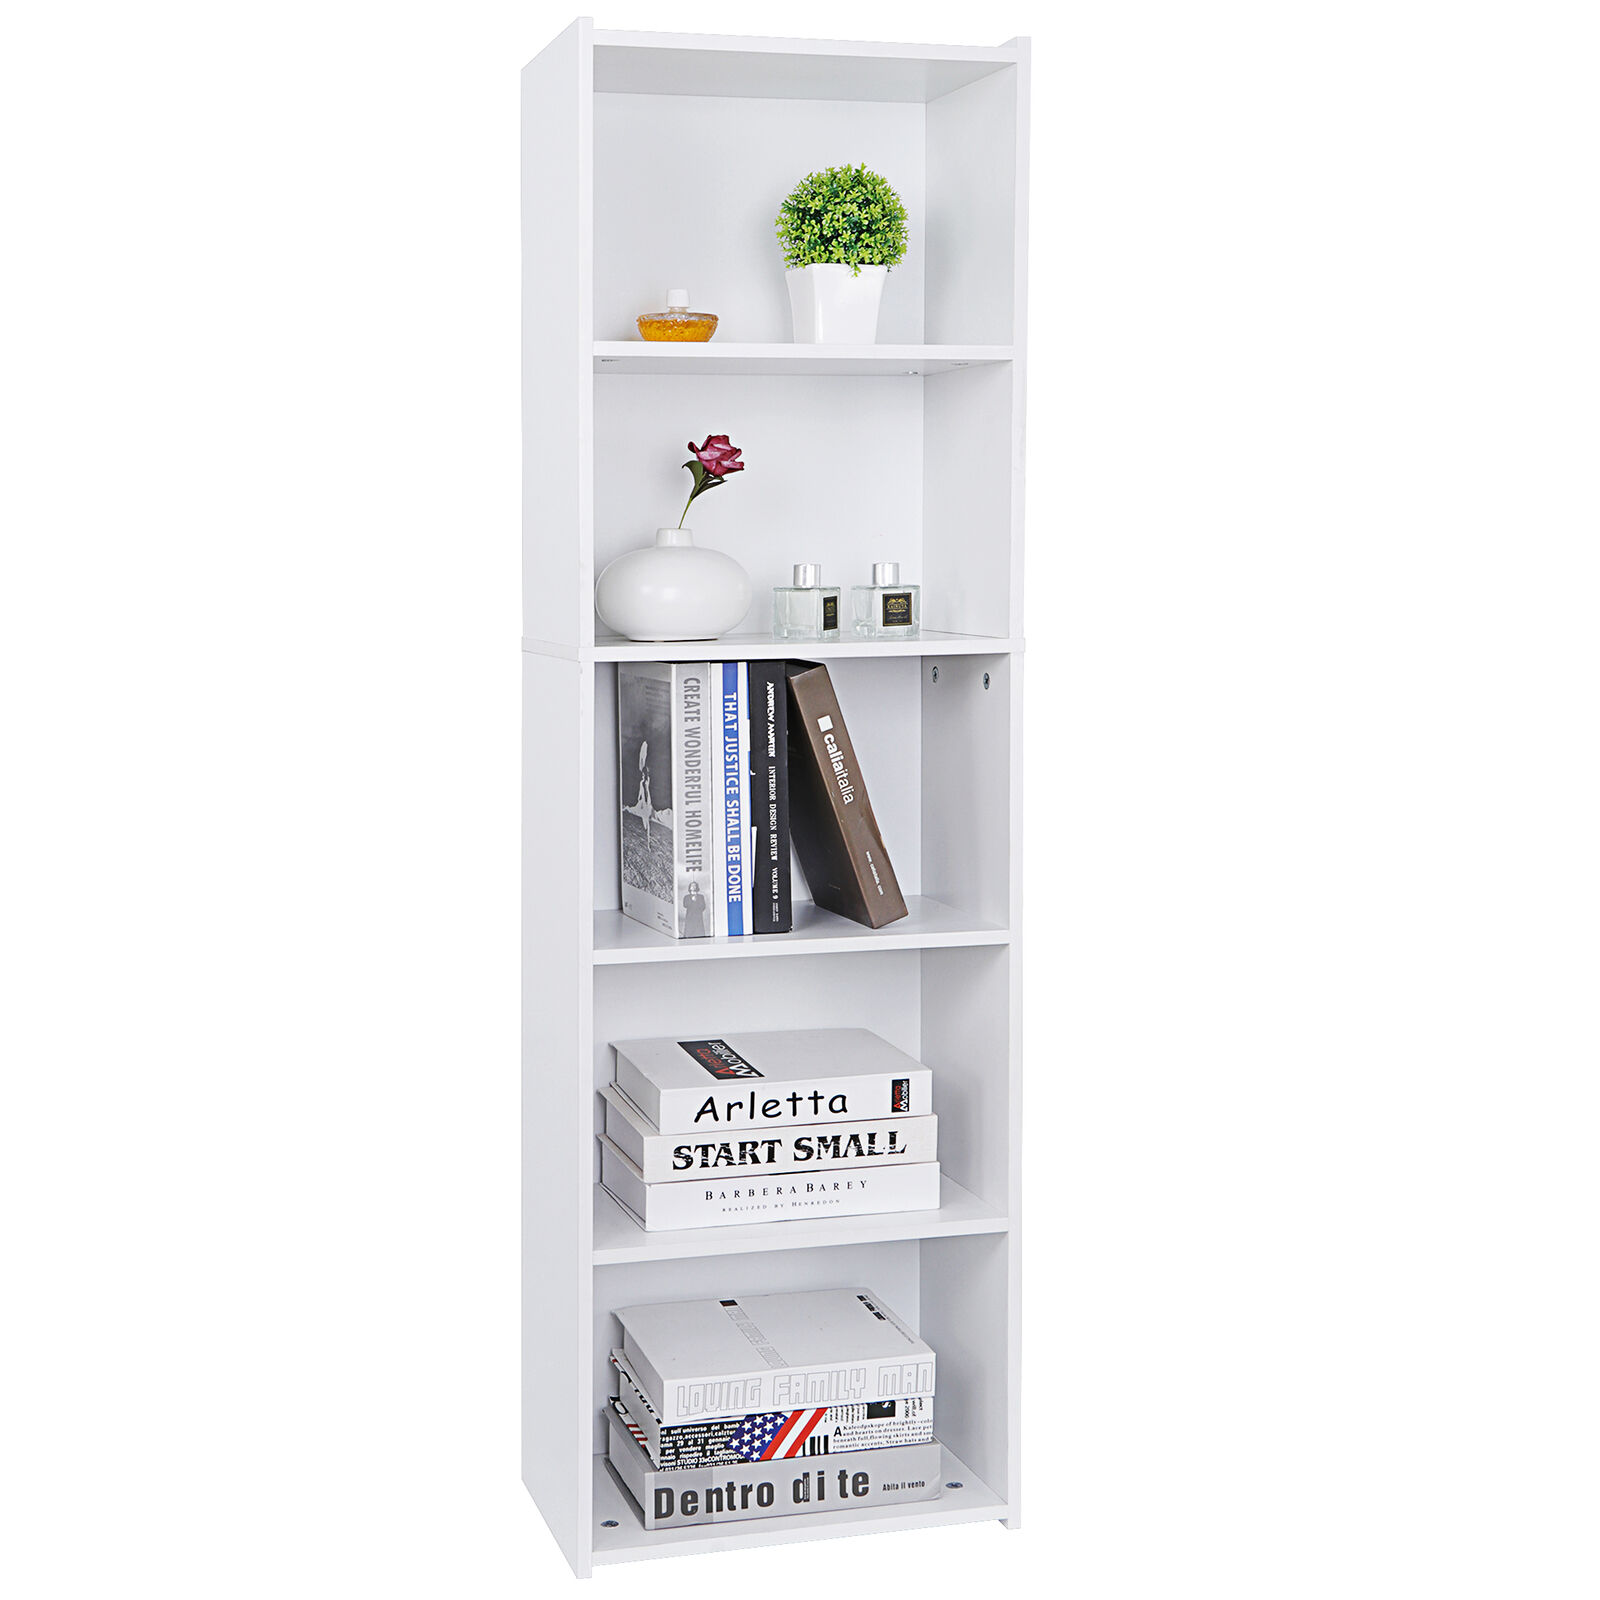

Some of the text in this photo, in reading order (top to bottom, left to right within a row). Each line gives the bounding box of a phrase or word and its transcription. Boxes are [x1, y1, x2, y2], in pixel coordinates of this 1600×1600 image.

[683, 677, 702, 872] CREATE WONDERFUL HOMELIFE
[768, 766, 777, 801] INTERIOR
[824, 733, 855, 805] caliaitalia
[724, 692, 741, 903] THAT JUSTICE SHALL BE DONE
[769, 804, 777, 830] DESIGN
[769, 833, 778, 860] REVIEW
[771, 867, 779, 894] VOLUME
[694, 1090, 848, 1123] Arletta
[672, 1131, 907, 1170] START SMALL
[705, 1180, 867, 1201] BARBERA BAREY
[677, 1362, 933, 1417] LOVING FAMILY MAN
[834, 1426, 842, 1437] A
[677, 1458, 698, 1466] STUDIO
[654, 1481, 775, 1520] Dentro
[792, 1470, 825, 1504] di
[837, 1469, 869, 1499] te
[882, 1483, 899, 1491] Abita
[908, 1480, 925, 1489] vento
